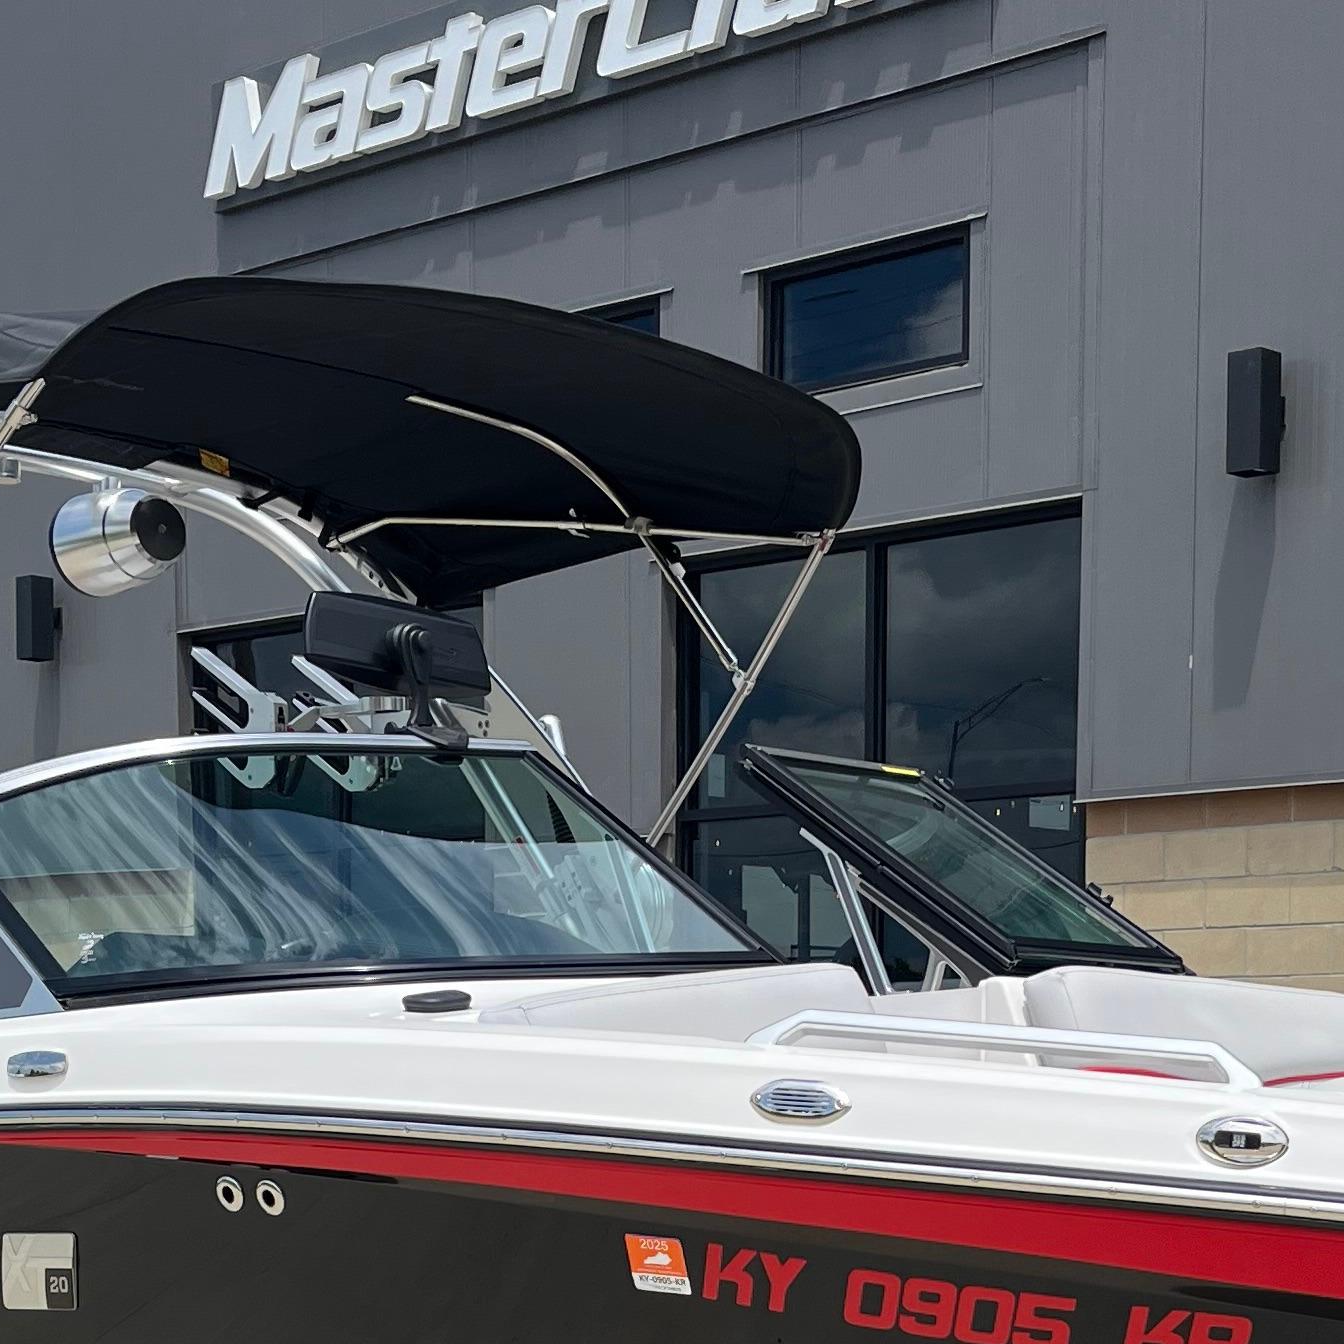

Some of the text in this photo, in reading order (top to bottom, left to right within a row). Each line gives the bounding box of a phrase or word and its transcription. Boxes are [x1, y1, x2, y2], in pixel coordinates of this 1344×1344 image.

[639, 1238, 669, 1251] 2025
[49, 1276, 69, 1293] 20
[701, 1243, 808, 1313] KY
